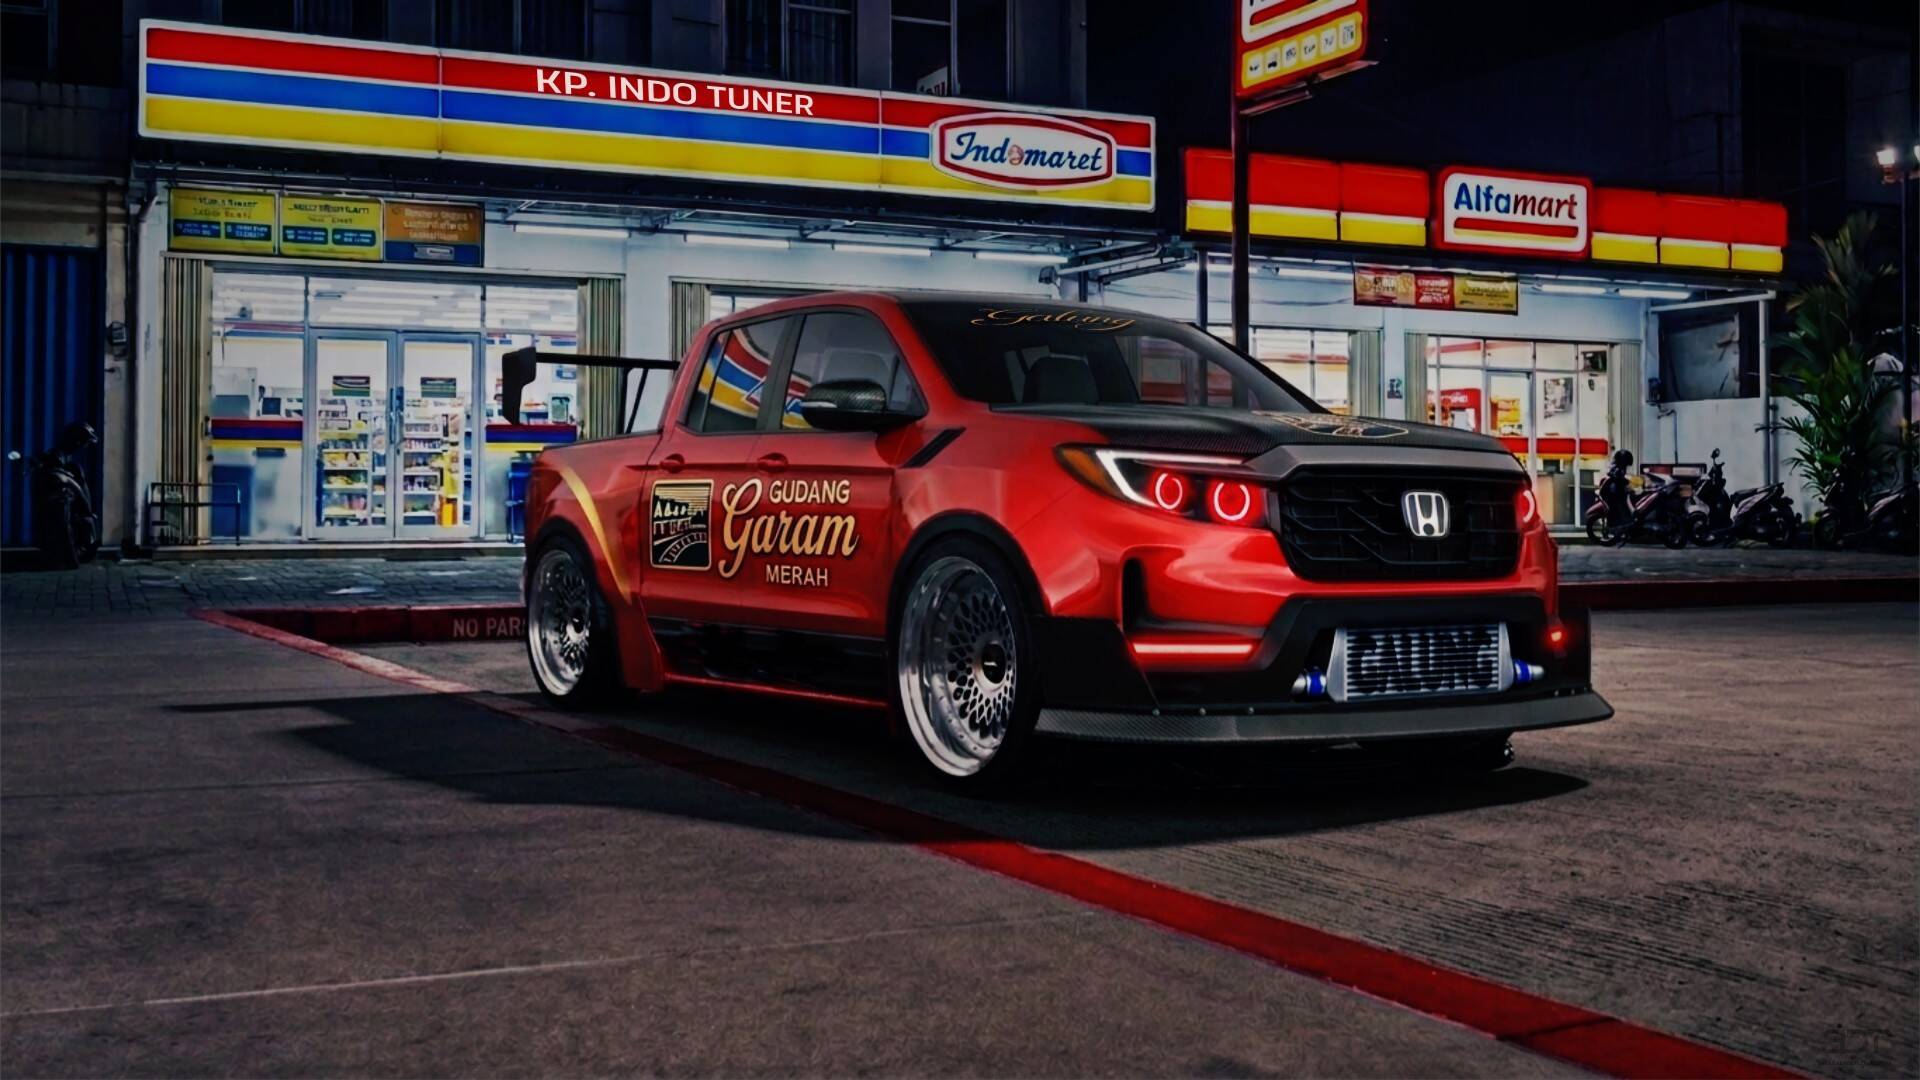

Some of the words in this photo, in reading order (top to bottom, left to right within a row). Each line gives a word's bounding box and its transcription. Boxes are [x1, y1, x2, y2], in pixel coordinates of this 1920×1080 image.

[536, 68, 596, 97] KP.
[608, 75, 697, 106] INDO
[706, 85, 814, 116] TUNER
[950, 131, 1103, 172] Indomaret
[1453, 182, 1578, 220] Alfamart
[769, 479, 850, 504] GUDANG
[718, 478, 860, 578] Garam
[765, 564, 829, 587] MERAH
[453, 617, 479, 638] NO
[485, 615, 526, 637] PAR
